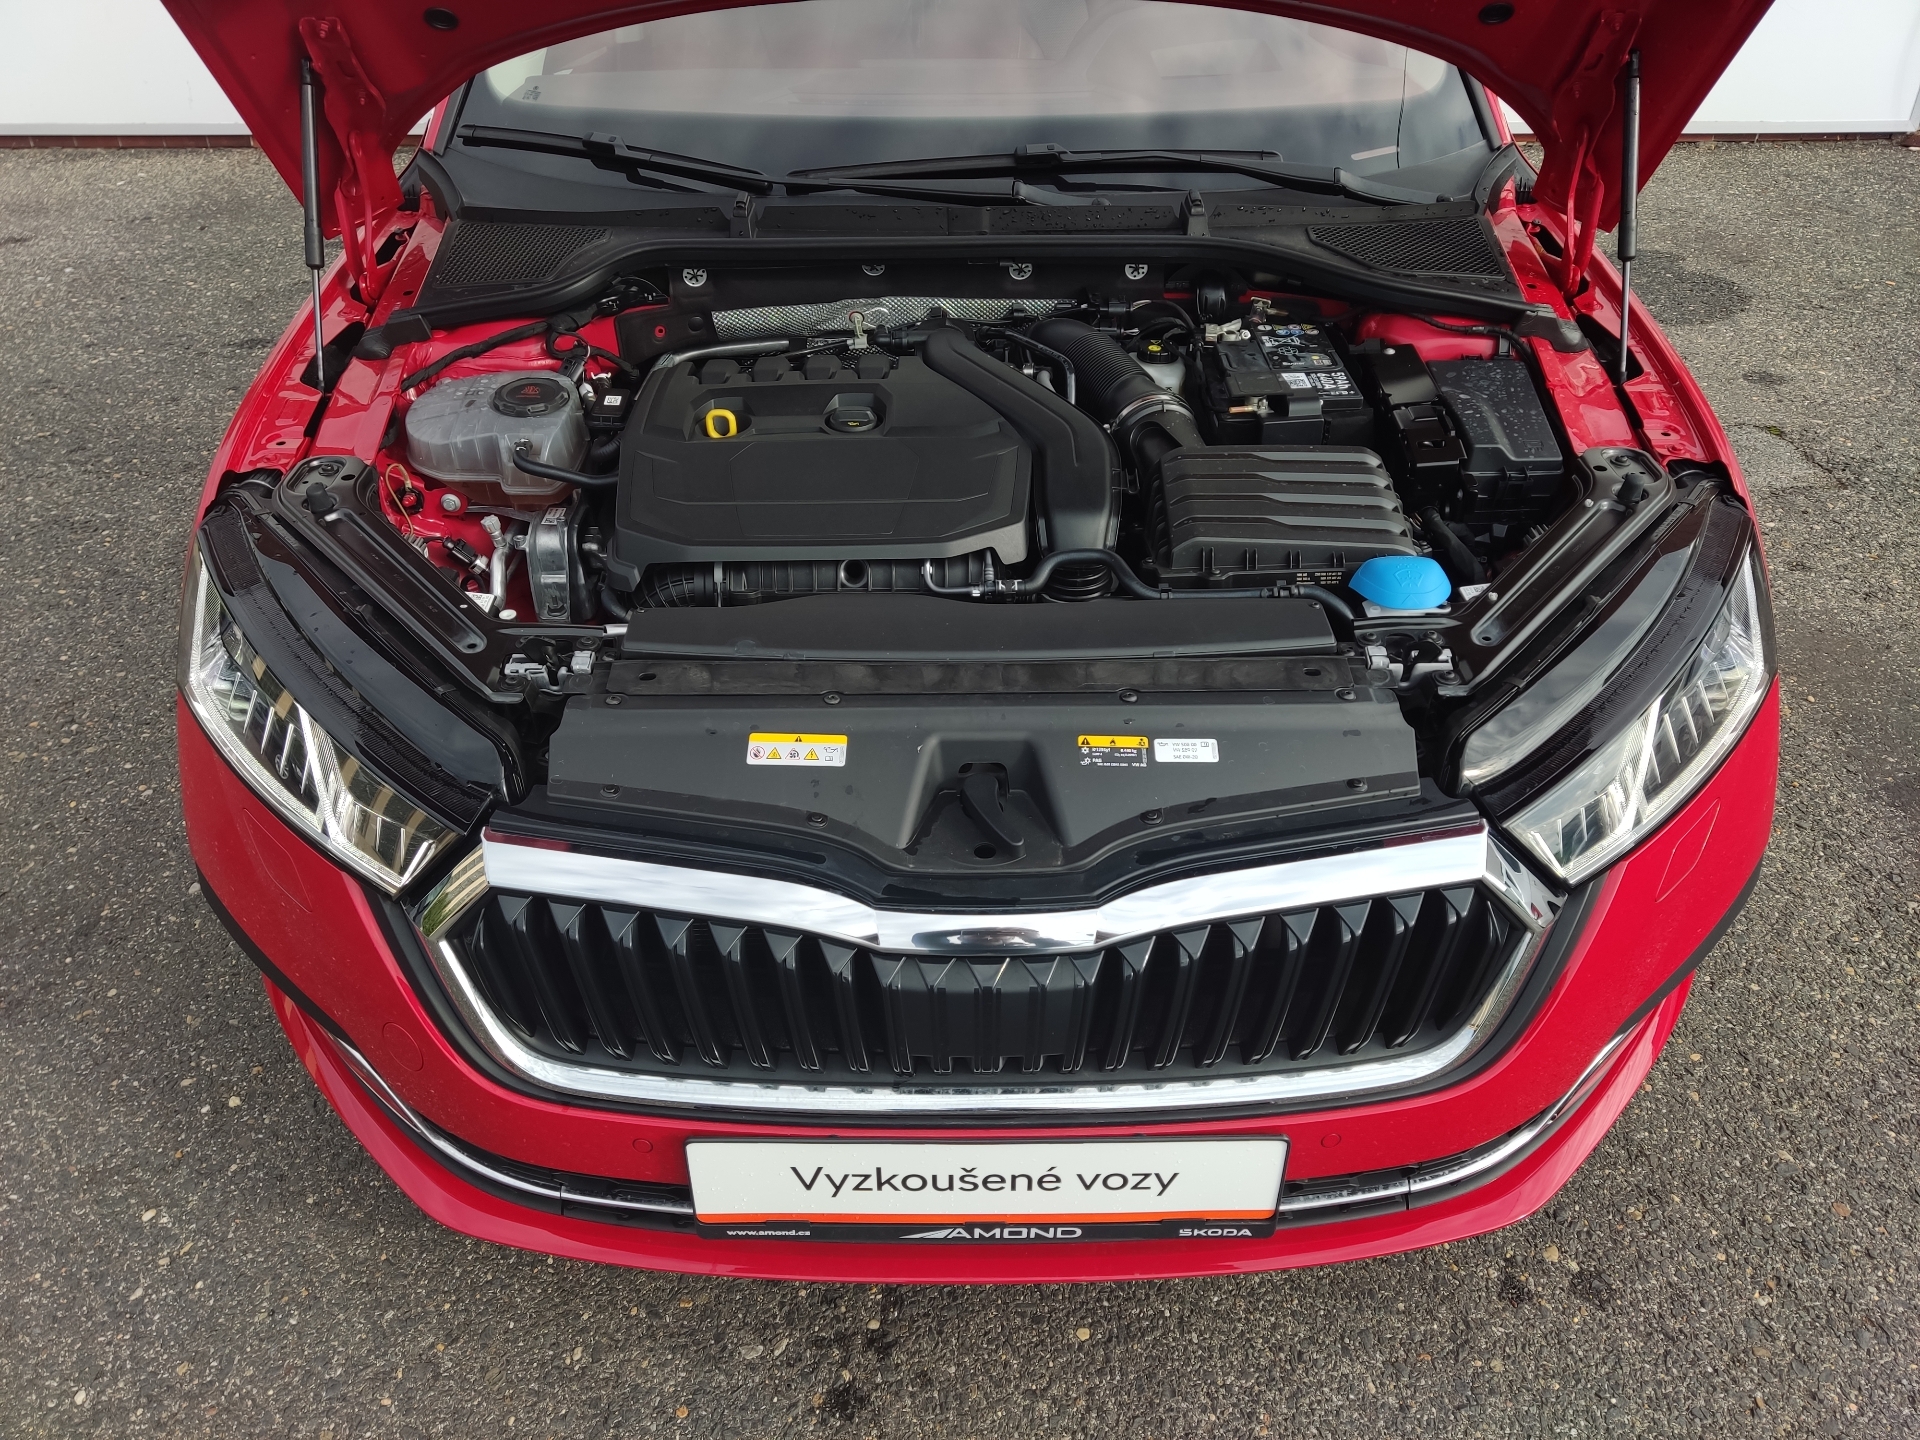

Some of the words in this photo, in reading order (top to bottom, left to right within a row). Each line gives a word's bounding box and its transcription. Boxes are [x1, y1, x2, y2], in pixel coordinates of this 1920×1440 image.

[789, 1166, 1062, 1198] Vyzkoušené
[1075, 1172, 1180, 1197] vozy
[946, 1227, 1083, 1239] AMOND
